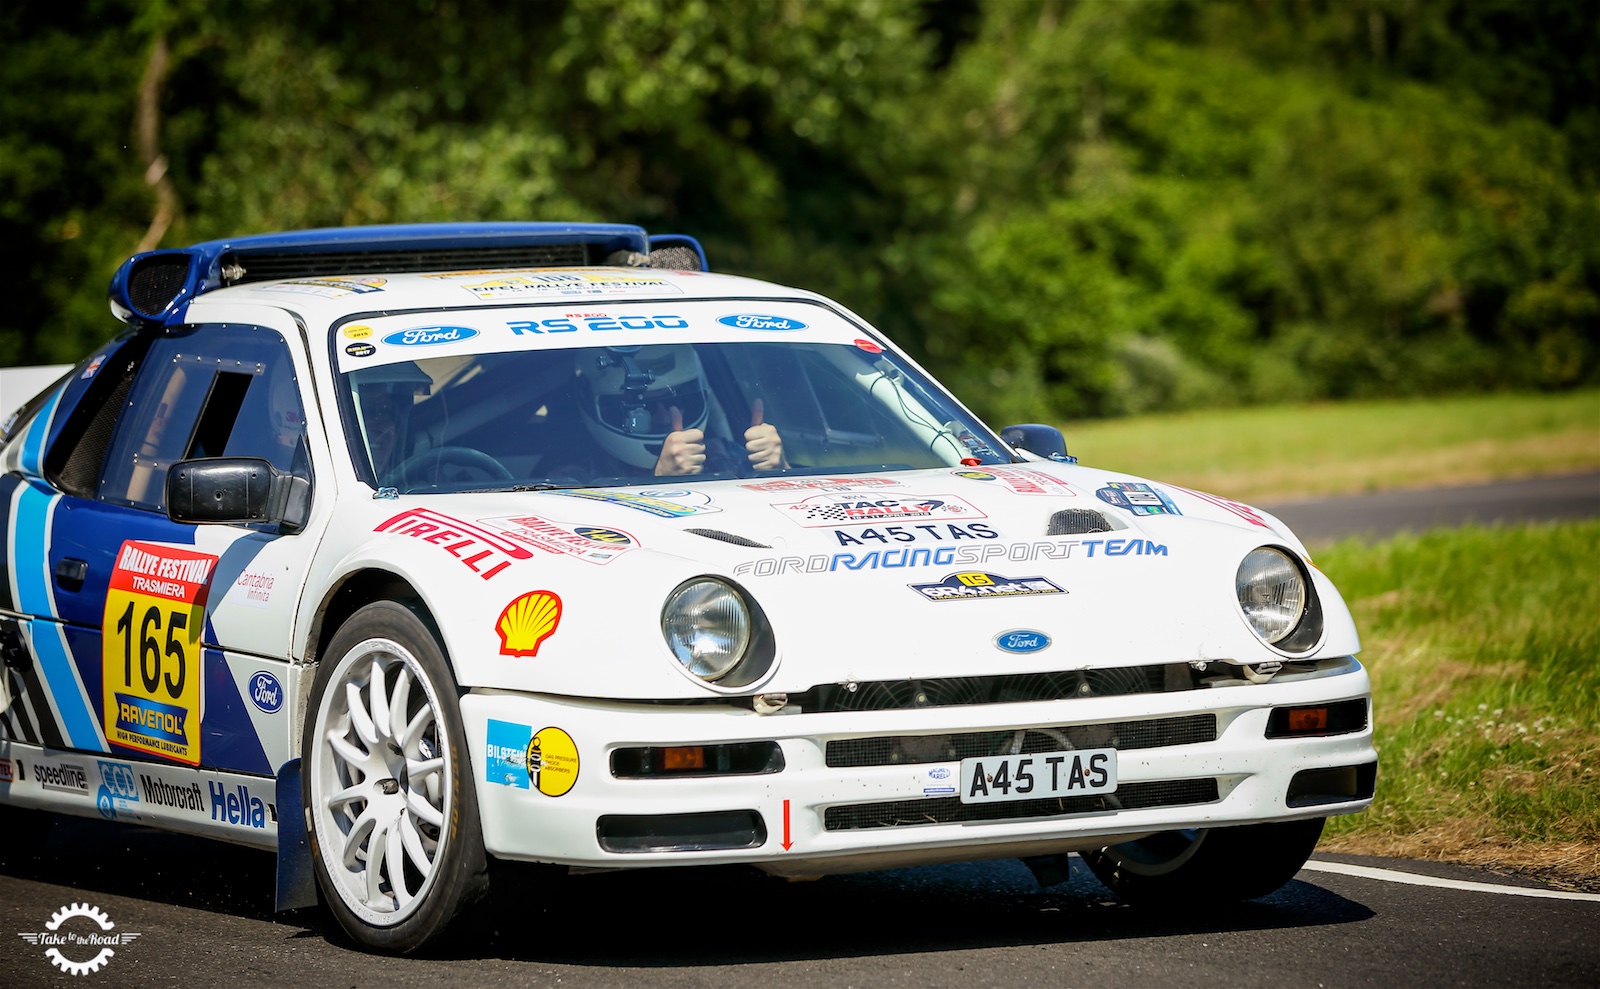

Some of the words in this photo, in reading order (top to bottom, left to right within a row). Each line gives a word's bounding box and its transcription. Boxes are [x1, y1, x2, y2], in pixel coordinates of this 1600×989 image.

[506, 319, 578, 336] RS
[584, 315, 689, 331] 200
[736, 315, 791, 330] Ford
[403, 327, 460, 345] Ford
[834, 500, 900, 510] TAC
[845, 505, 933, 517] RALLY
[372, 507, 534, 581] PIRELLI
[834, 526, 915, 547] A45
[915, 523, 999, 541] TAS
[1081, 539, 1168, 557] TEAM
[119, 544, 160, 576] RALLYE
[157, 557, 213, 585] FESTIVAL
[132, 576, 185, 599] TRASMIERA
[237, 568, 275, 590] Cantabria
[921, 583, 1025, 597] 6R4.net
[961, 575, 989, 585] 15
[246, 588, 270, 602] Infinita
[117, 601, 188, 699] 165
[254, 675, 278, 707] Ford
[117, 730, 128, 741] HIGH
[129, 734, 160, 749] PERFORMANCE
[161, 741, 188, 756] LUBRICANTS
[544, 765, 571, 774] ABSORBERS
[555, 754, 577, 763] PRESSURE
[34, 763, 86, 789] speedline
[969, 759, 1034, 798] A45
[1046, 753, 1108, 791] TAS
[139, 774, 205, 812] Motorcraft
[208, 780, 265, 829] Hella
